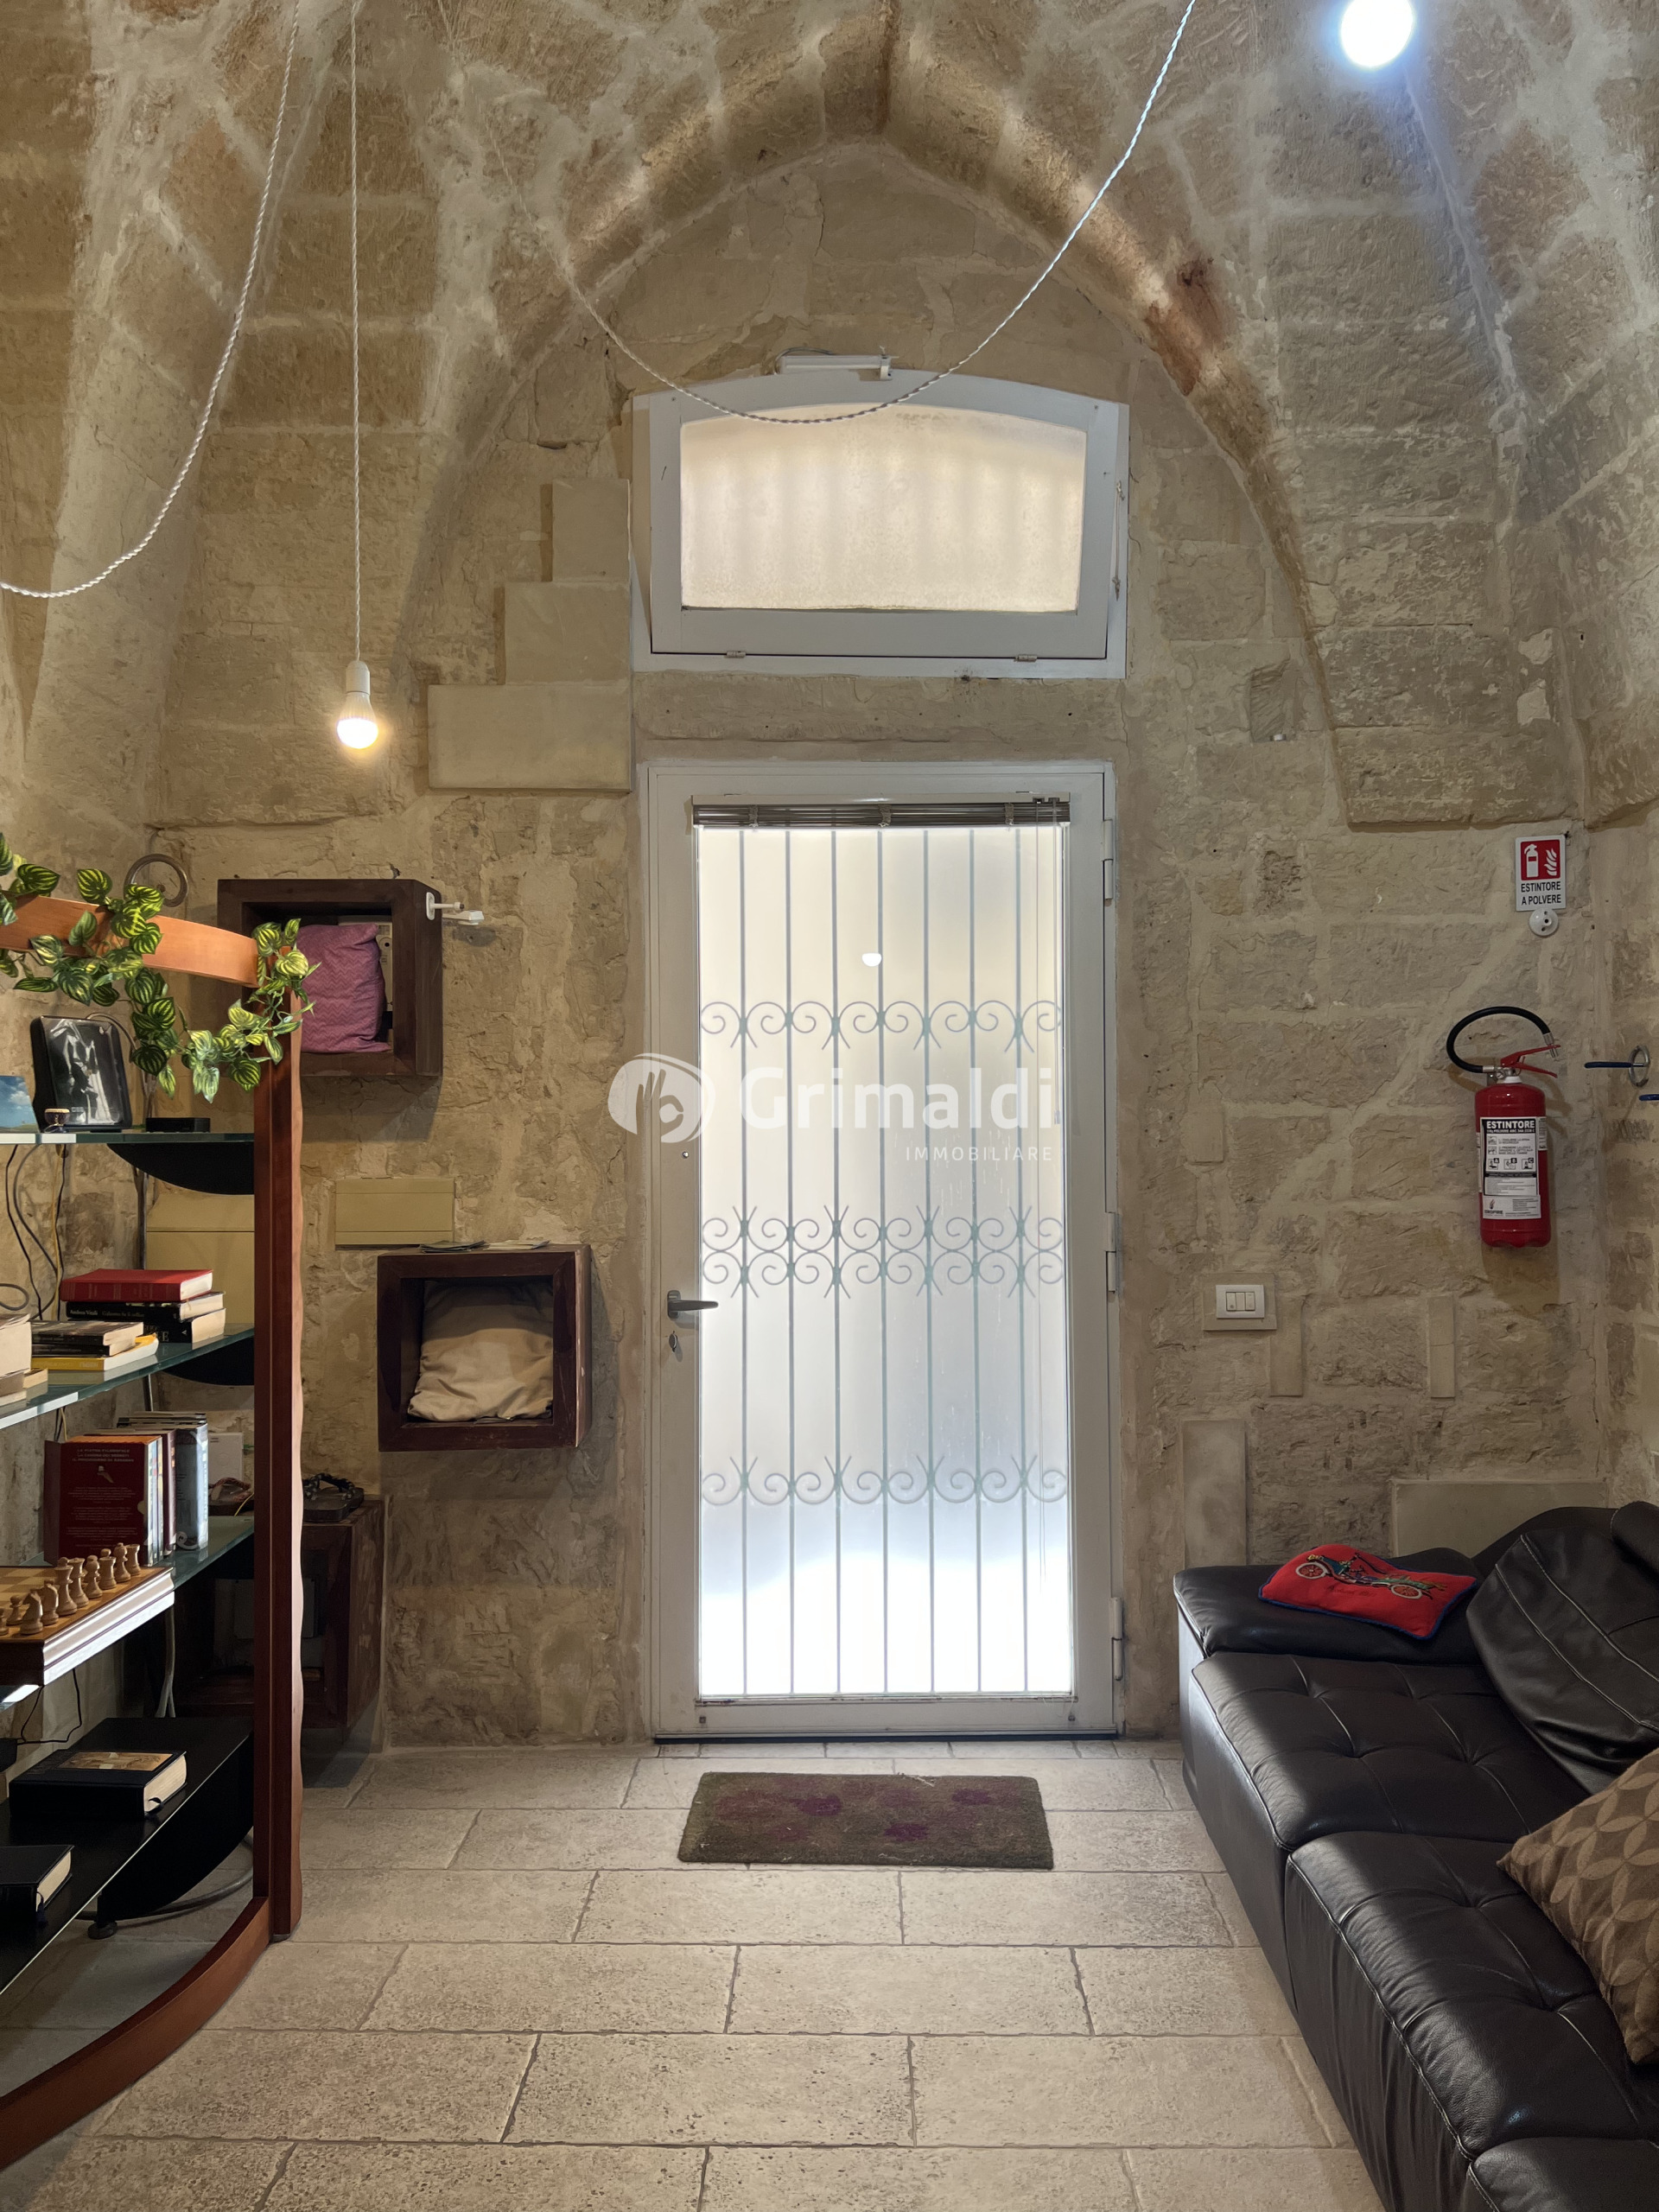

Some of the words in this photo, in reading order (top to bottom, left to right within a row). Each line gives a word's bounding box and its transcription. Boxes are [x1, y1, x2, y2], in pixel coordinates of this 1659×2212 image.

[1521, 881, 1561, 893] ESTINTORE
[1522, 897, 1528, 906] A
[1529, 894, 1561, 905] POLVERE
[1486, 1121, 1535, 1129] ESTINTORE
